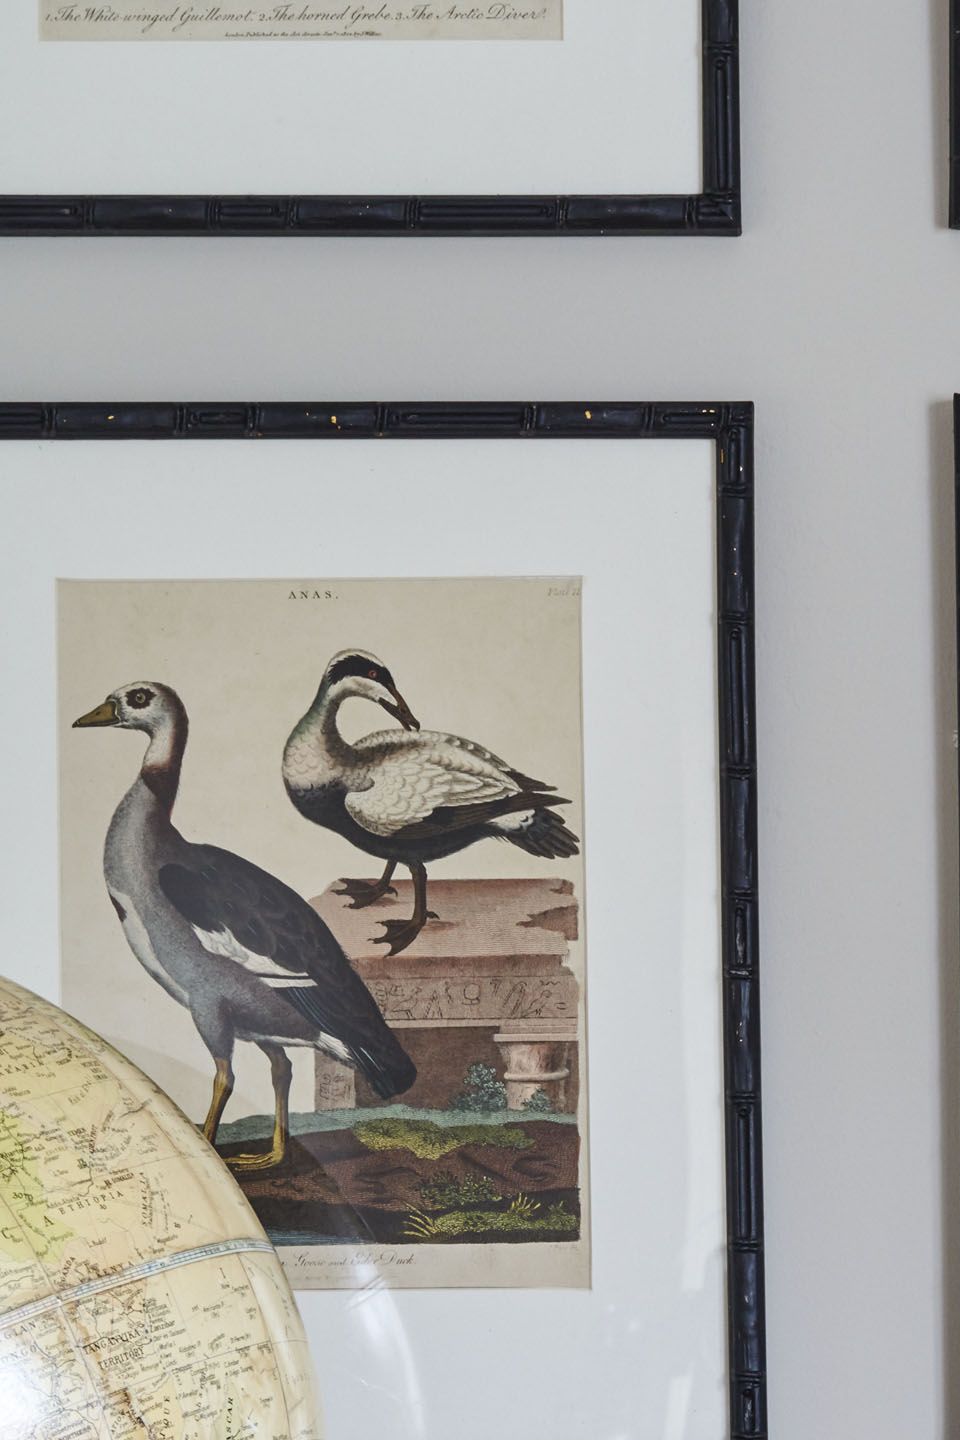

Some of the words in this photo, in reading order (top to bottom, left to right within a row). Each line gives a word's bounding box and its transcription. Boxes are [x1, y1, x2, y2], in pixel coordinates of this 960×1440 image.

[54, 4, 83, 22] The
[266, 4, 297, 21] The
[299, 5, 350, 21] horned
[405, 4, 435, 20] The
[436, 5, 484, 20] Arctic
[289, 590, 339, 599] ANAS.
[59, 1190, 124, 1216] ETHIOPIA
[83, 1328, 143, 1355] TANGANYIKA
[98, 1346, 145, 1371] TERRITORY
